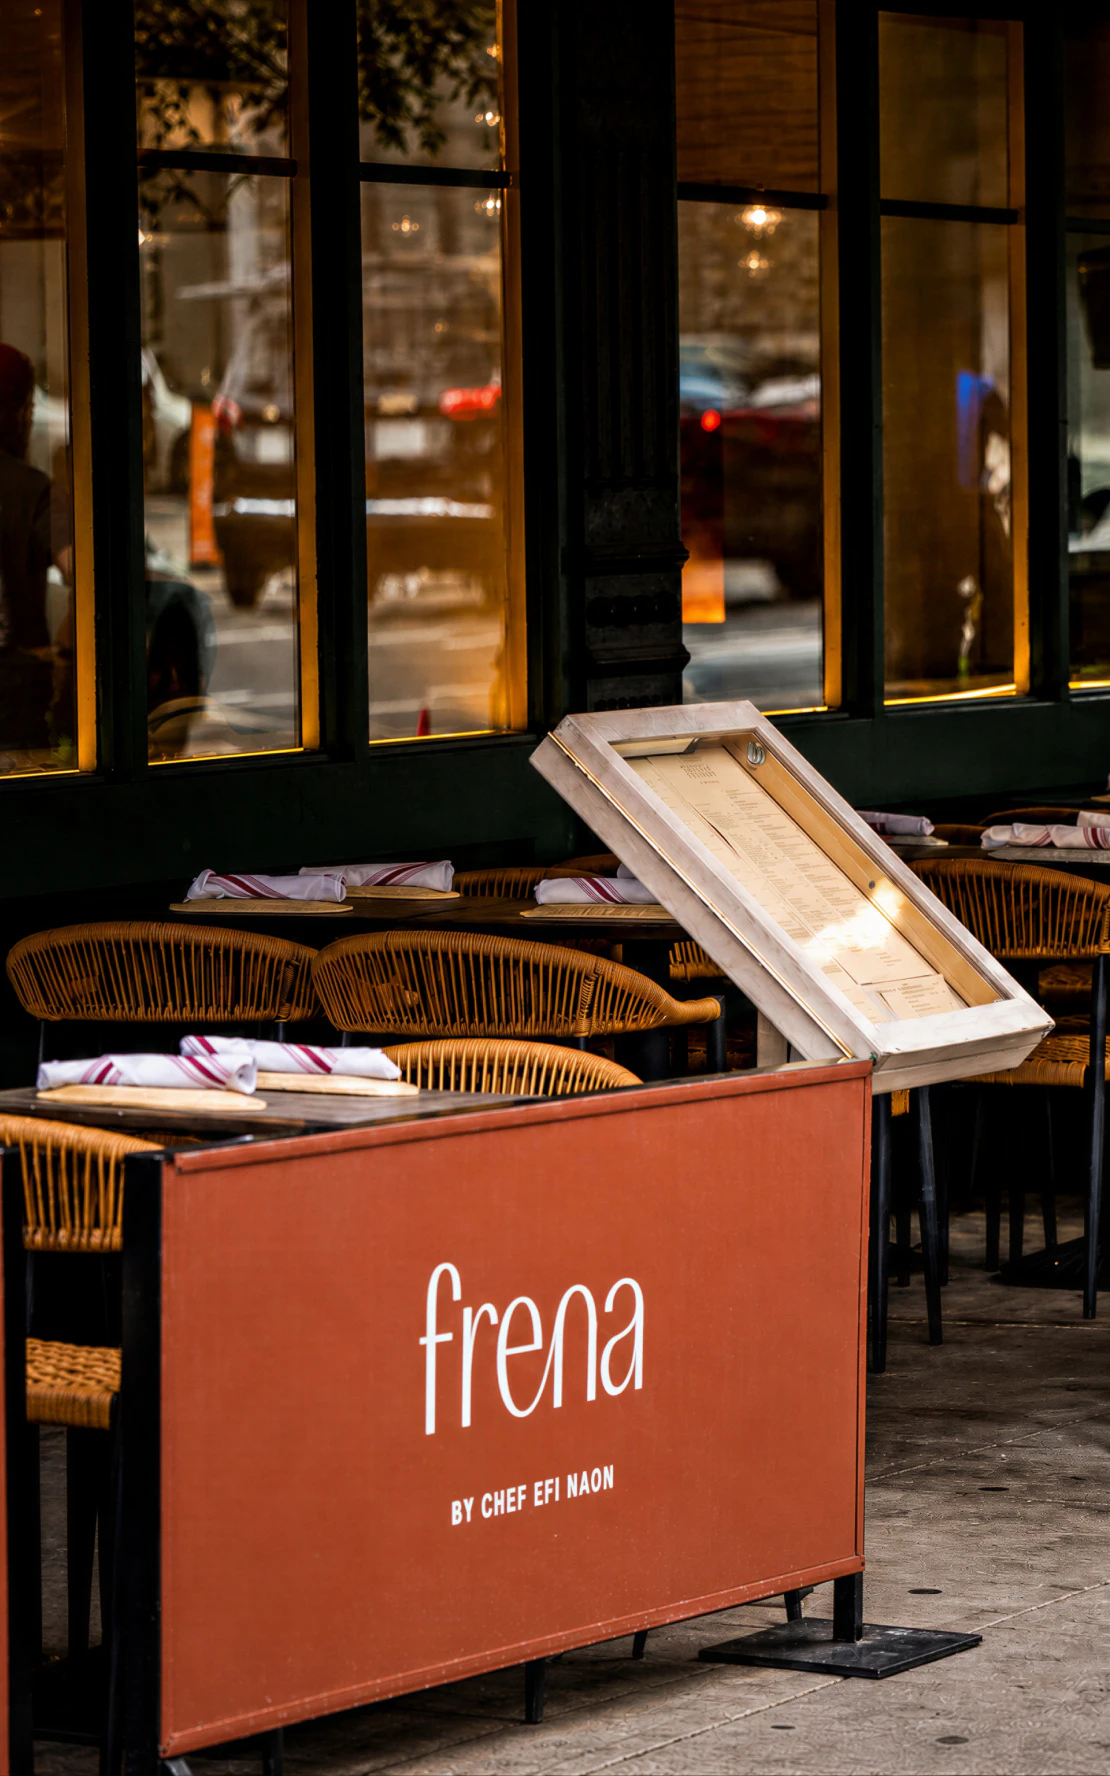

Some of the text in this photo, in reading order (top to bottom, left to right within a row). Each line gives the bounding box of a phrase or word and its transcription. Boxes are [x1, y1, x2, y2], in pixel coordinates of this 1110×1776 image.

[419, 1262, 645, 1435] frena
[451, 1464, 614, 1526] BY CHEF EFI NAON
